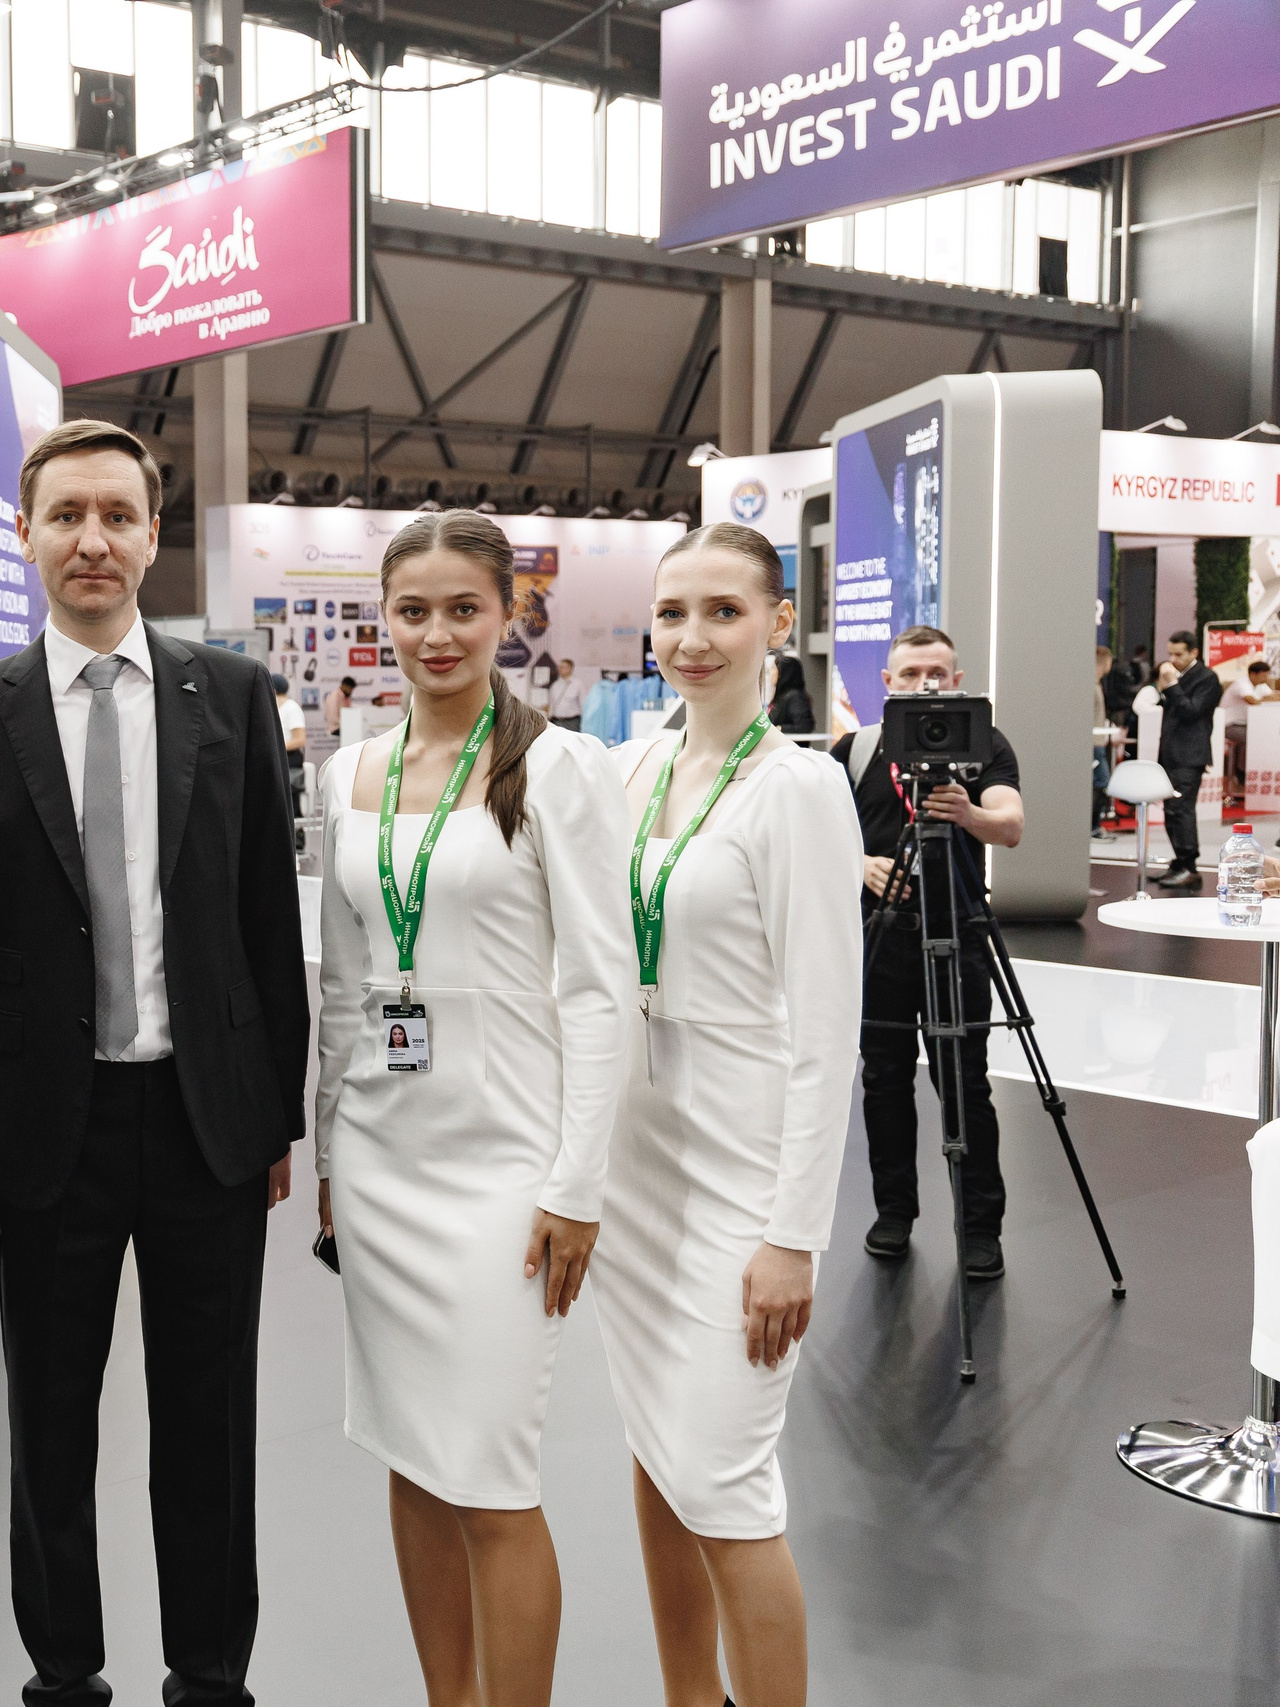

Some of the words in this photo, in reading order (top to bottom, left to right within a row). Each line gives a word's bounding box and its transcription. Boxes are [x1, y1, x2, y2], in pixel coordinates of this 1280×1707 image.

[873, 21, 912, 84] في
[709, 37, 867, 130] السعودية
[709, 98, 876, 189] INVEST
[890, 46, 1061, 141] SAUDI
[129, 311, 173, 340] Добро
[174, 289, 263, 325] пожаловать
[199, 323, 209, 339] в
[210, 307, 270, 341] Аравию
[1112, 474, 1178, 499] KYRGYZ
[1181, 478, 1255, 503] REPUBLIC
[836, 561, 864, 580] WELCOME
[467, 714, 489, 749] INNOPROM
[729, 731, 754, 762] INNOPROM
[387, 779, 398, 815] ИННОПРОМ
[443, 760, 466, 800] ИННОПРОМ
[422, 811, 442, 849] INNOPROM
[642, 799, 660, 837] ИННОПРОМ
[665, 824, 693, 862] ИННОПРОМ
[408, 862, 421, 910] ИННОПРОМ
[634, 850, 642, 888] INNOPROM
[389, 878, 403, 924] ИННОПРОМ
[649, 875, 662, 917] INNOPROM
